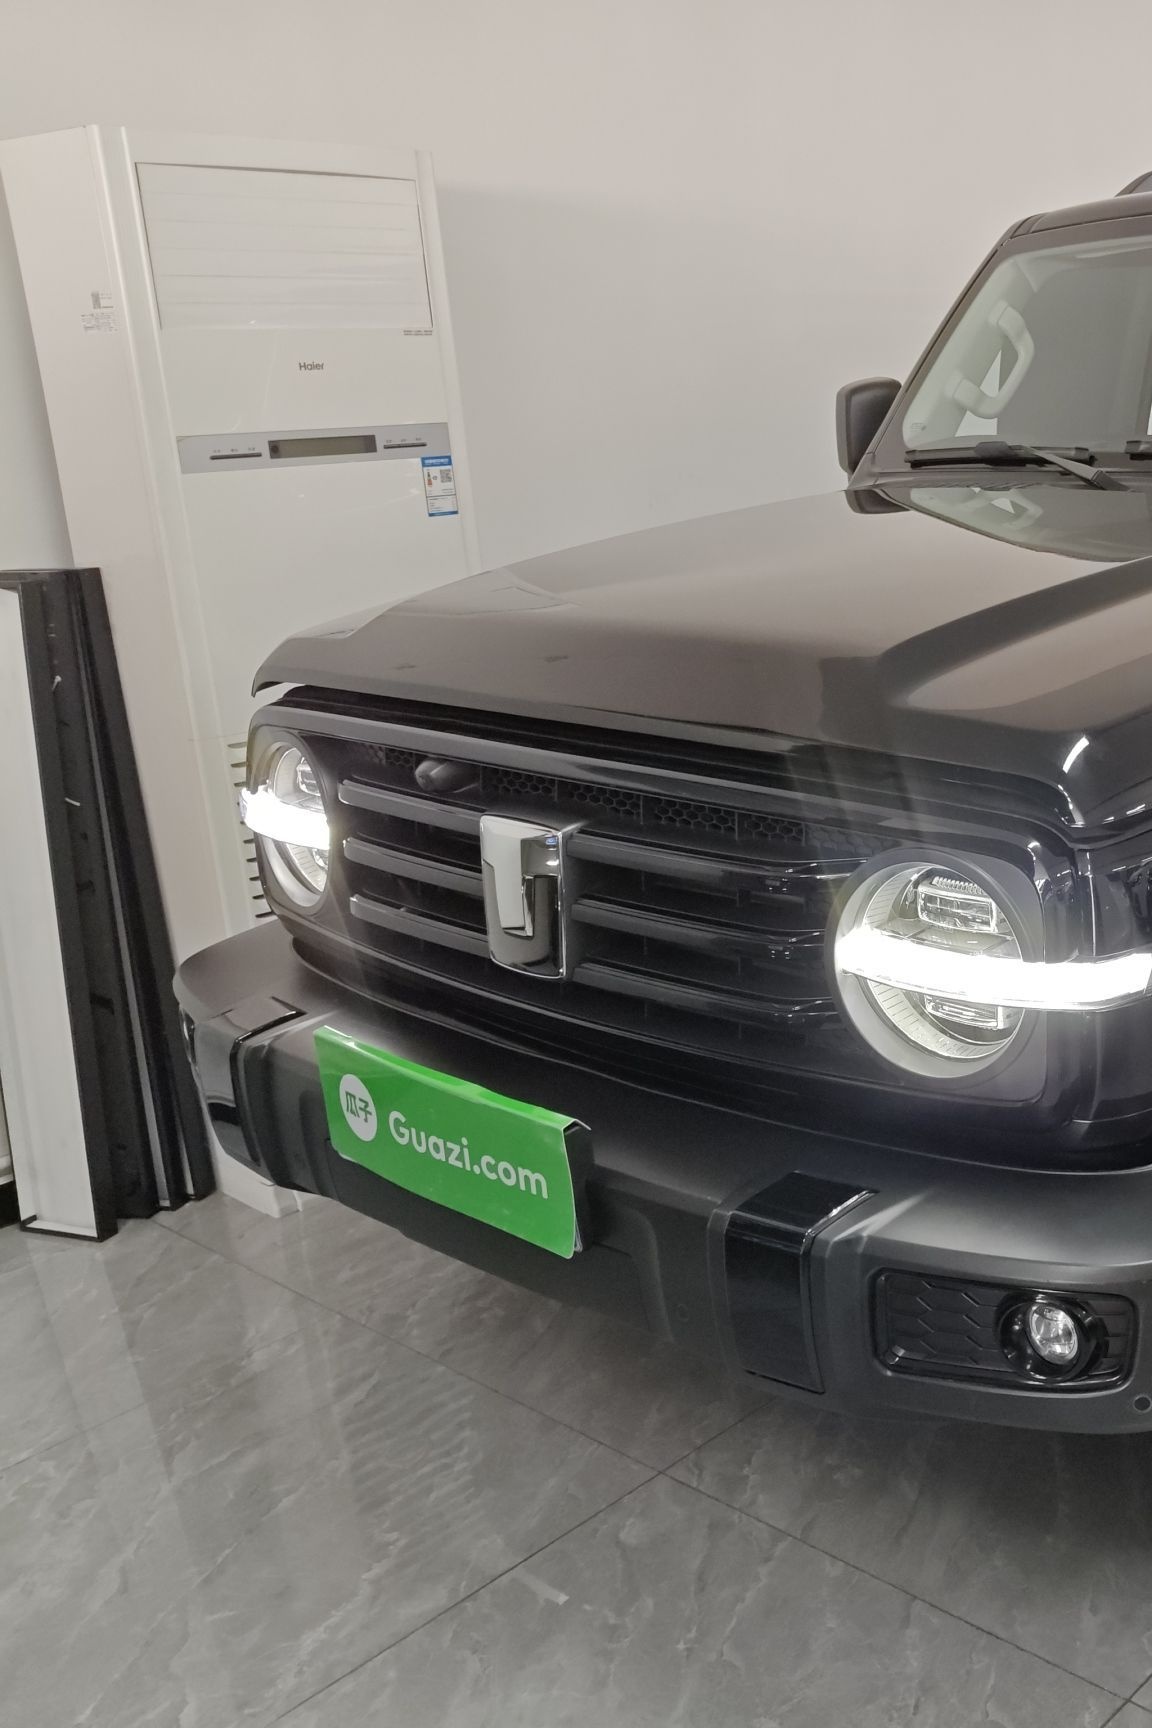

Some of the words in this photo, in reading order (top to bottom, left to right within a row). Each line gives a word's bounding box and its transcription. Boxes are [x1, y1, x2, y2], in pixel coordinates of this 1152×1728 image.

[298, 361, 325, 372] Haier
[344, 1090, 373, 1123] 瓜子
[388, 1110, 549, 1199] Guazi.com
